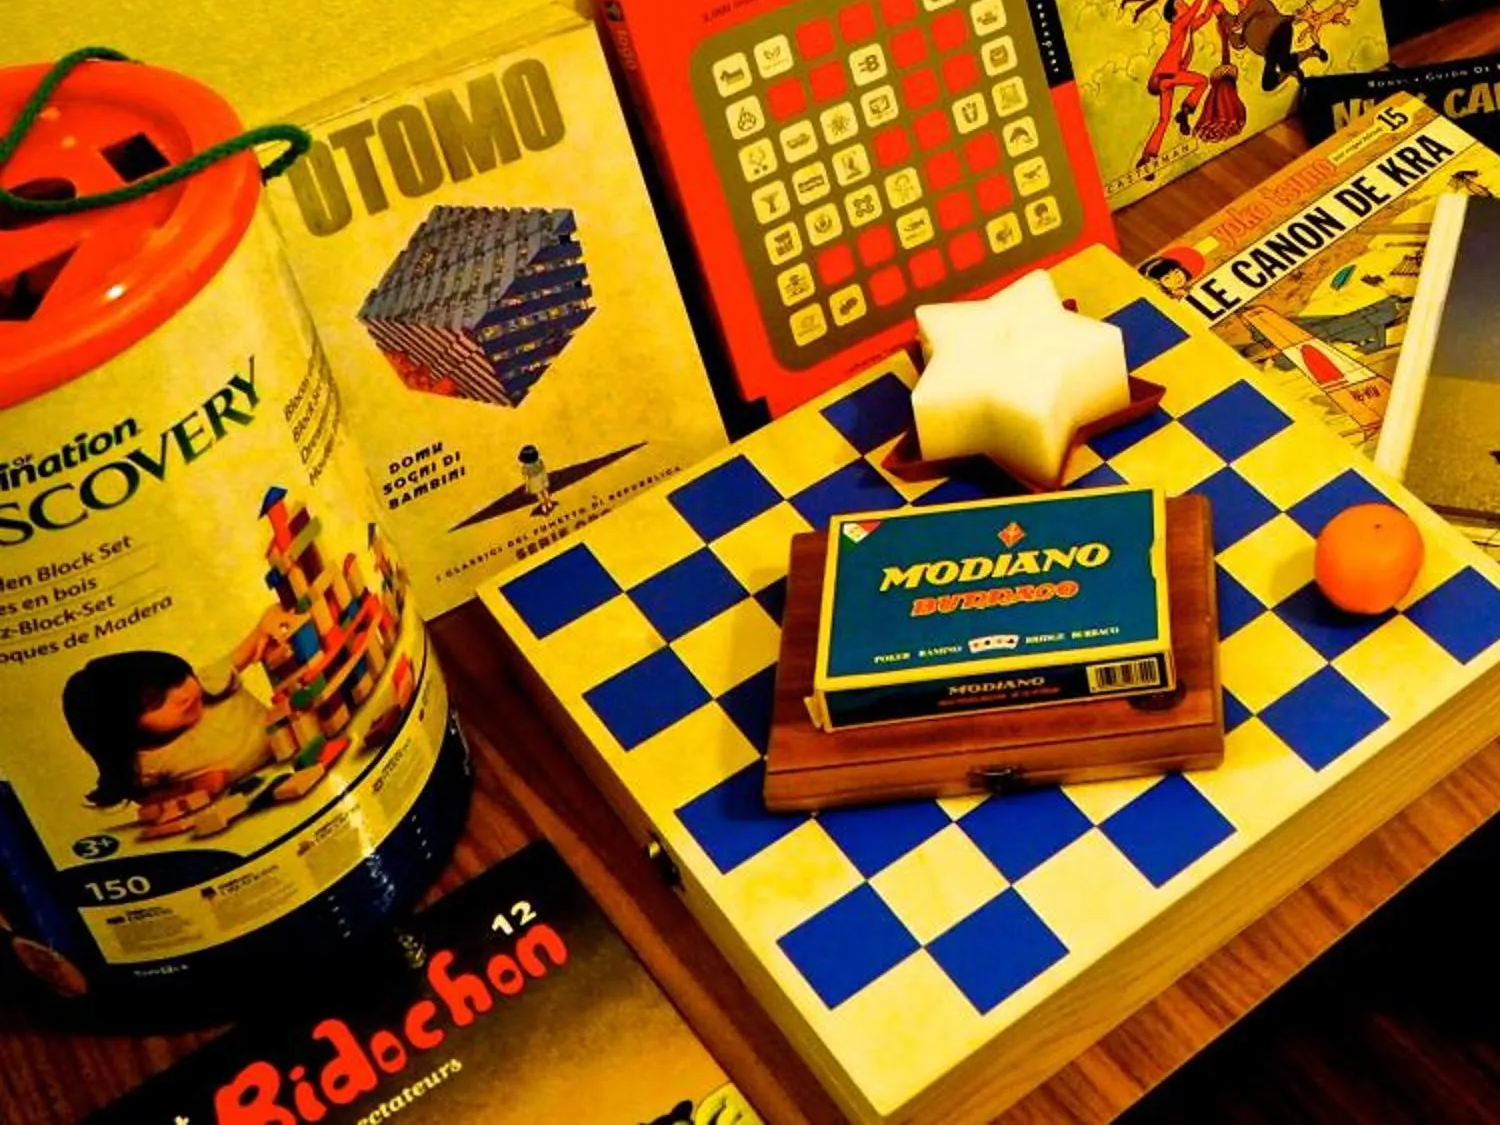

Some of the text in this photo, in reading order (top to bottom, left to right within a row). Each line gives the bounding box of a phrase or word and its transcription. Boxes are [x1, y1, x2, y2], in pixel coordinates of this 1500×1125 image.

[1379, 107, 1410, 131] 15
[290, 59, 565, 238] OTOMO
[1185, 278, 1242, 321] LE
[1231, 206, 1346, 289] CANON
[1333, 176, 1391, 218] DE
[1377, 134, 1455, 187] KRA
[383, 451, 461, 495] SOGNI DI
[389, 441, 444, 474] DOMU
[389, 466, 465, 510] BAMBINI
[37, 552, 95, 582] Block
[99, 535, 131, 560] Set
[879, 542, 1110, 592] MODIANO
[22, 595, 48, 610] en
[54, 578, 97, 602] bois
[64, 632, 89, 649] de
[95, 595, 173, 638] Madera
[948, 676, 1045, 695] MODIANO
[83, 837, 112, 858] 3+
[85, 876, 150, 901] 150
[492, 899, 537, 937] 12
[214, 923, 569, 1125] Bidochon
